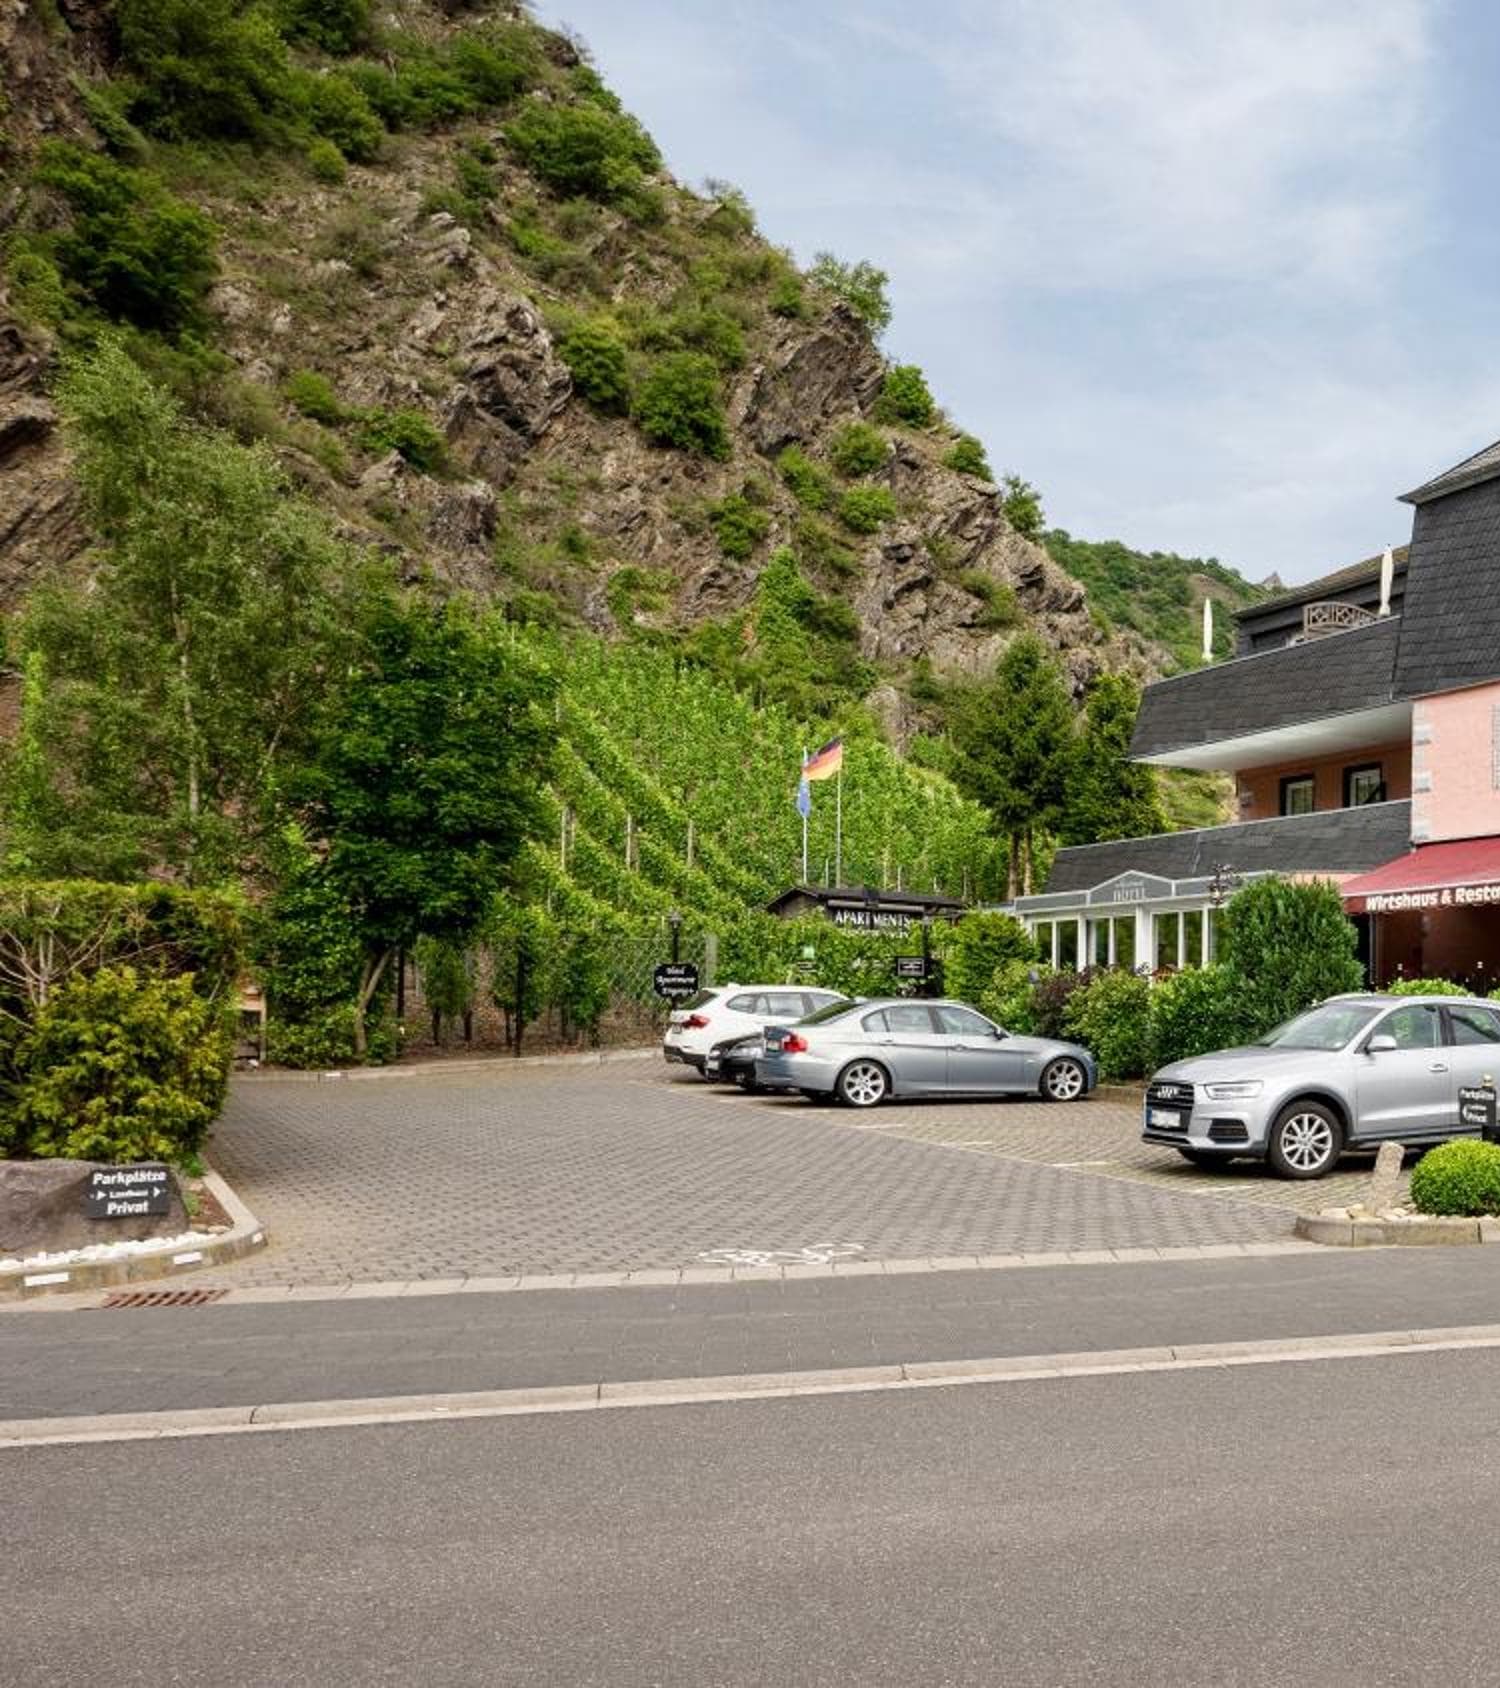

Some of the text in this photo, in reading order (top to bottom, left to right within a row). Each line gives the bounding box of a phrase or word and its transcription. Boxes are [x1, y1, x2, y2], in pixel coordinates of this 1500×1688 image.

[1365, 891, 1437, 911] Wirtshaus
[1441, 890, 1452, 905] &
[92, 1169, 167, 1186] Parkplätze
[106, 1200, 149, 1215] Privat
